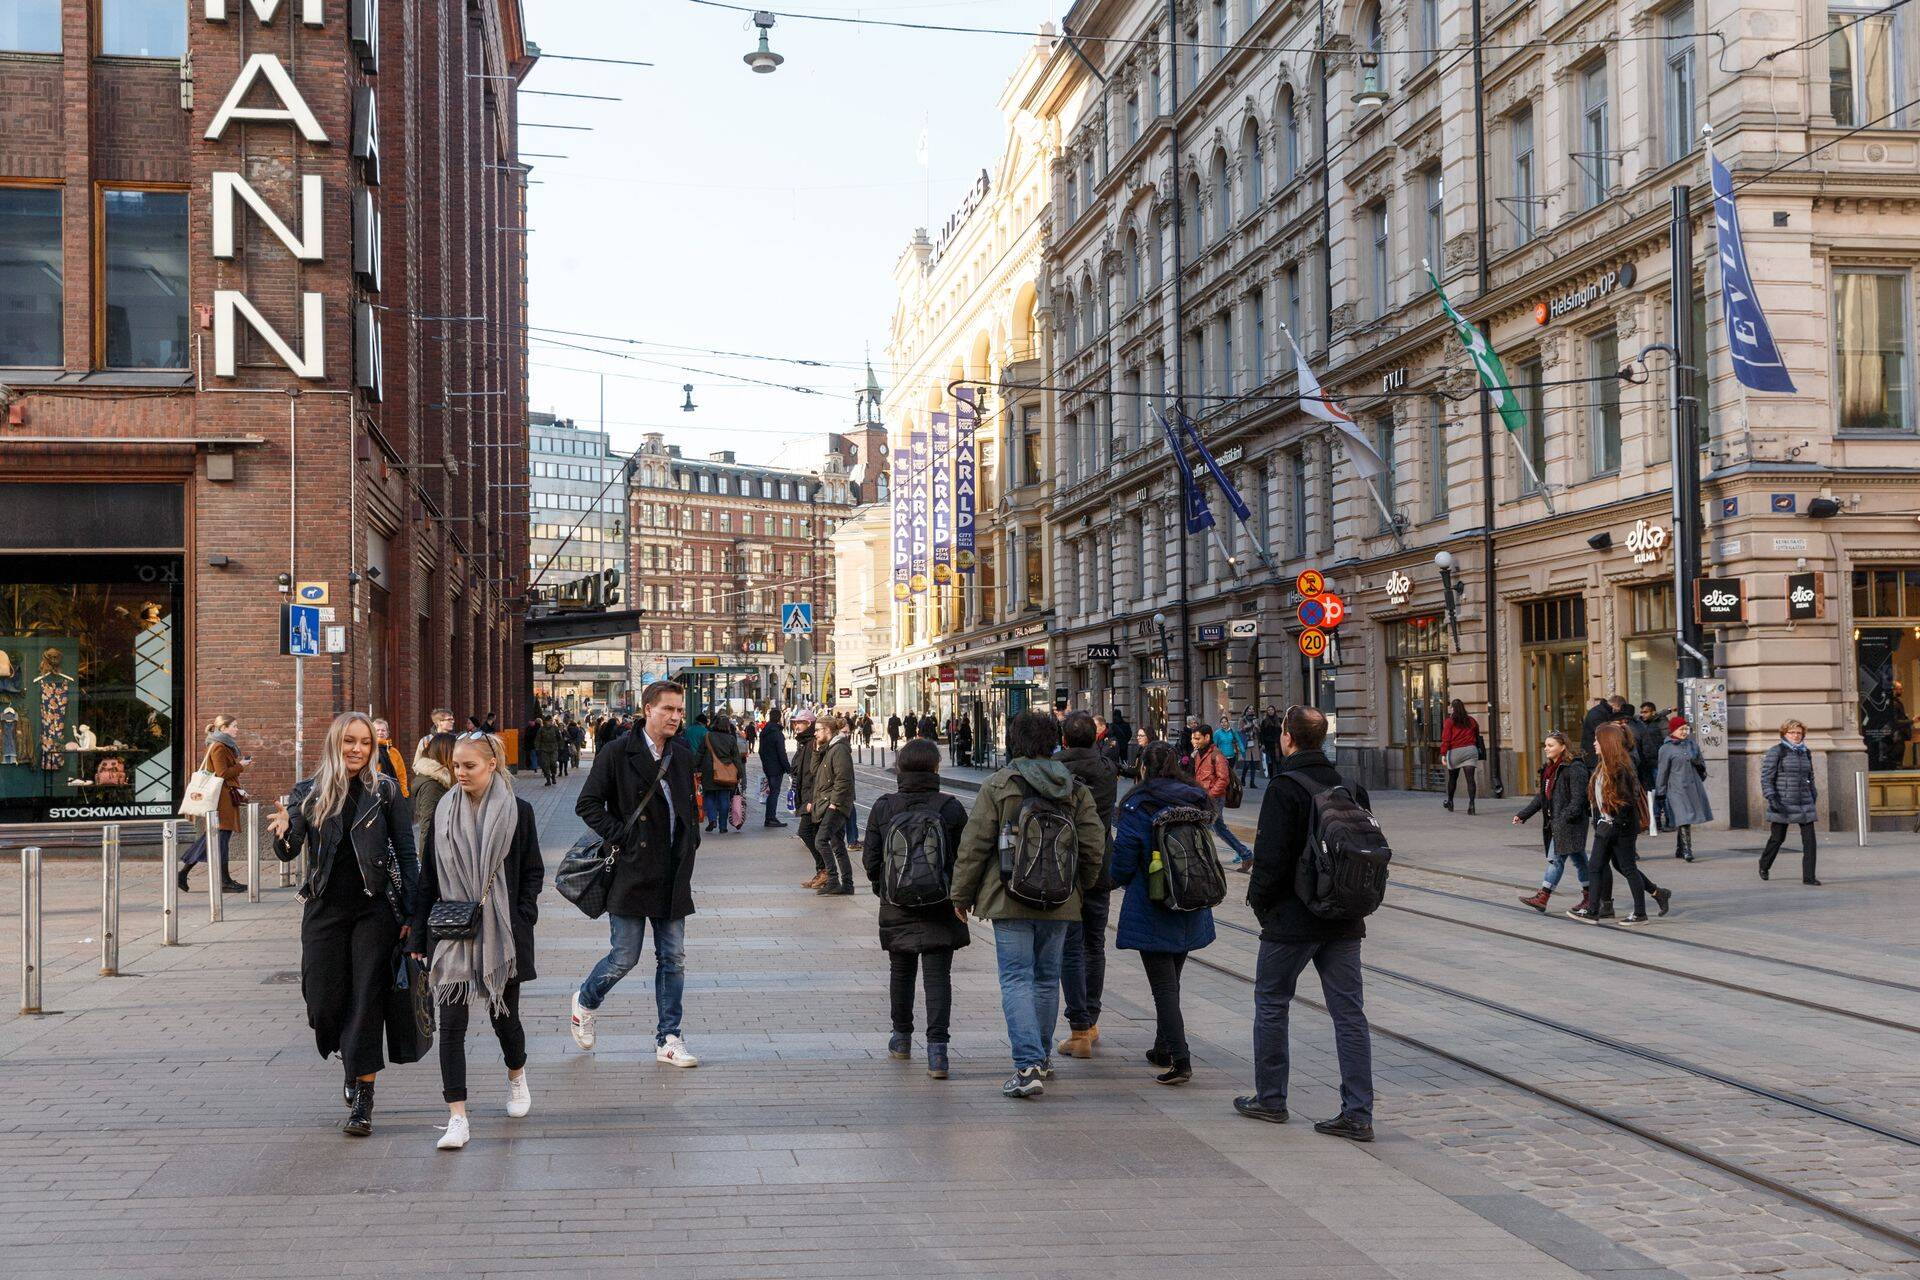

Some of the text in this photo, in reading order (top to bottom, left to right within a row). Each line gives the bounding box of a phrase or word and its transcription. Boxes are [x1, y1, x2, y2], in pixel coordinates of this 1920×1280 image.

[204, 0, 329, 379] ANN
[1550, 271, 1616, 319] Helsingin OP
[1717, 215, 1758, 348] EVLI
[1383, 367, 1404, 392] EVLI
[957, 431, 975, 528] HARALD
[911, 470, 927, 556] HARALD
[934, 453, 950, 544] HARALD
[895, 485, 910, 566] HARALD
[1625, 519, 1667, 552] elisa
[1634, 552, 1657, 564] KULMA
[1386, 570, 1411, 596] elisa
[1702, 589, 1739, 606] elisa
[1790, 586, 1815, 603] elisa
[1088, 648, 1118, 657] ZARA
[1304, 635, 1321, 650] 20
